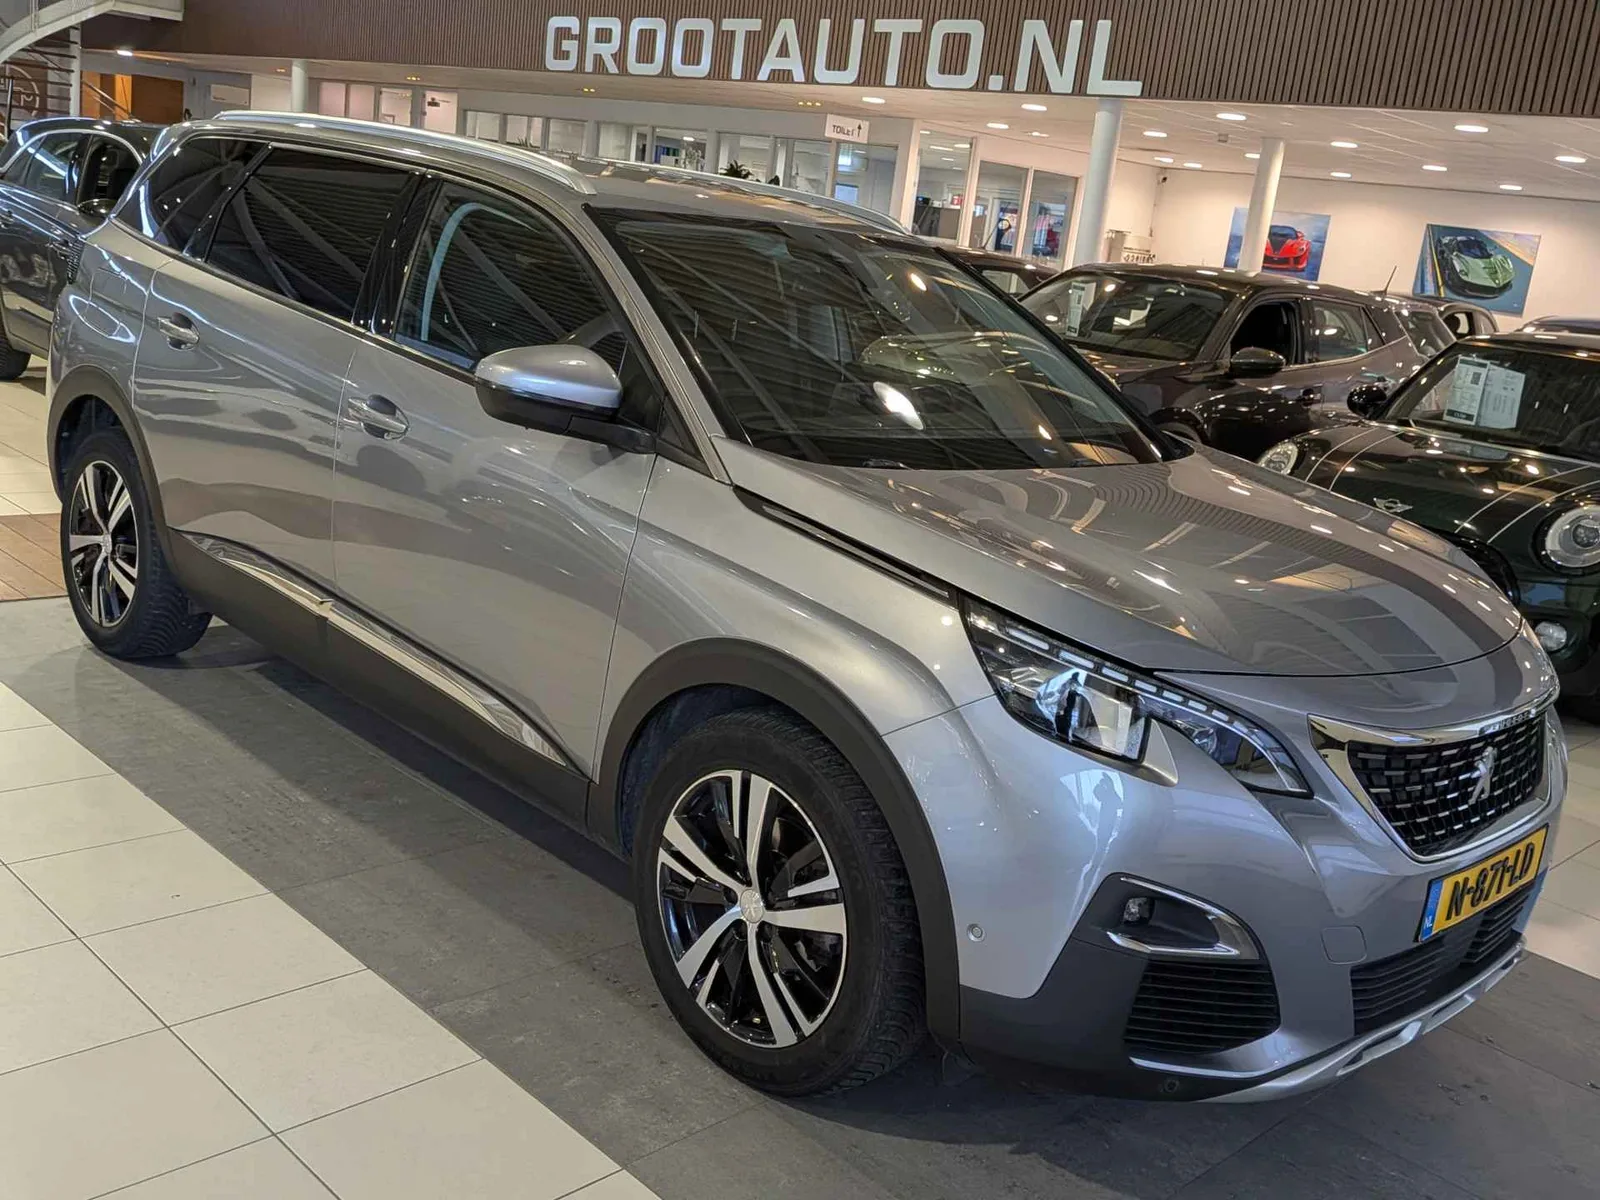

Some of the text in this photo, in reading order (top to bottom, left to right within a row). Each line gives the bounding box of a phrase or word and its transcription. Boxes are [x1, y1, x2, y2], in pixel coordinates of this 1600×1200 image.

[545, 16, 1142, 97] GROOTAUTO.NL
[832, 124, 856, 137] TOILET
[1445, 842, 1535, 921] N-871-LD
